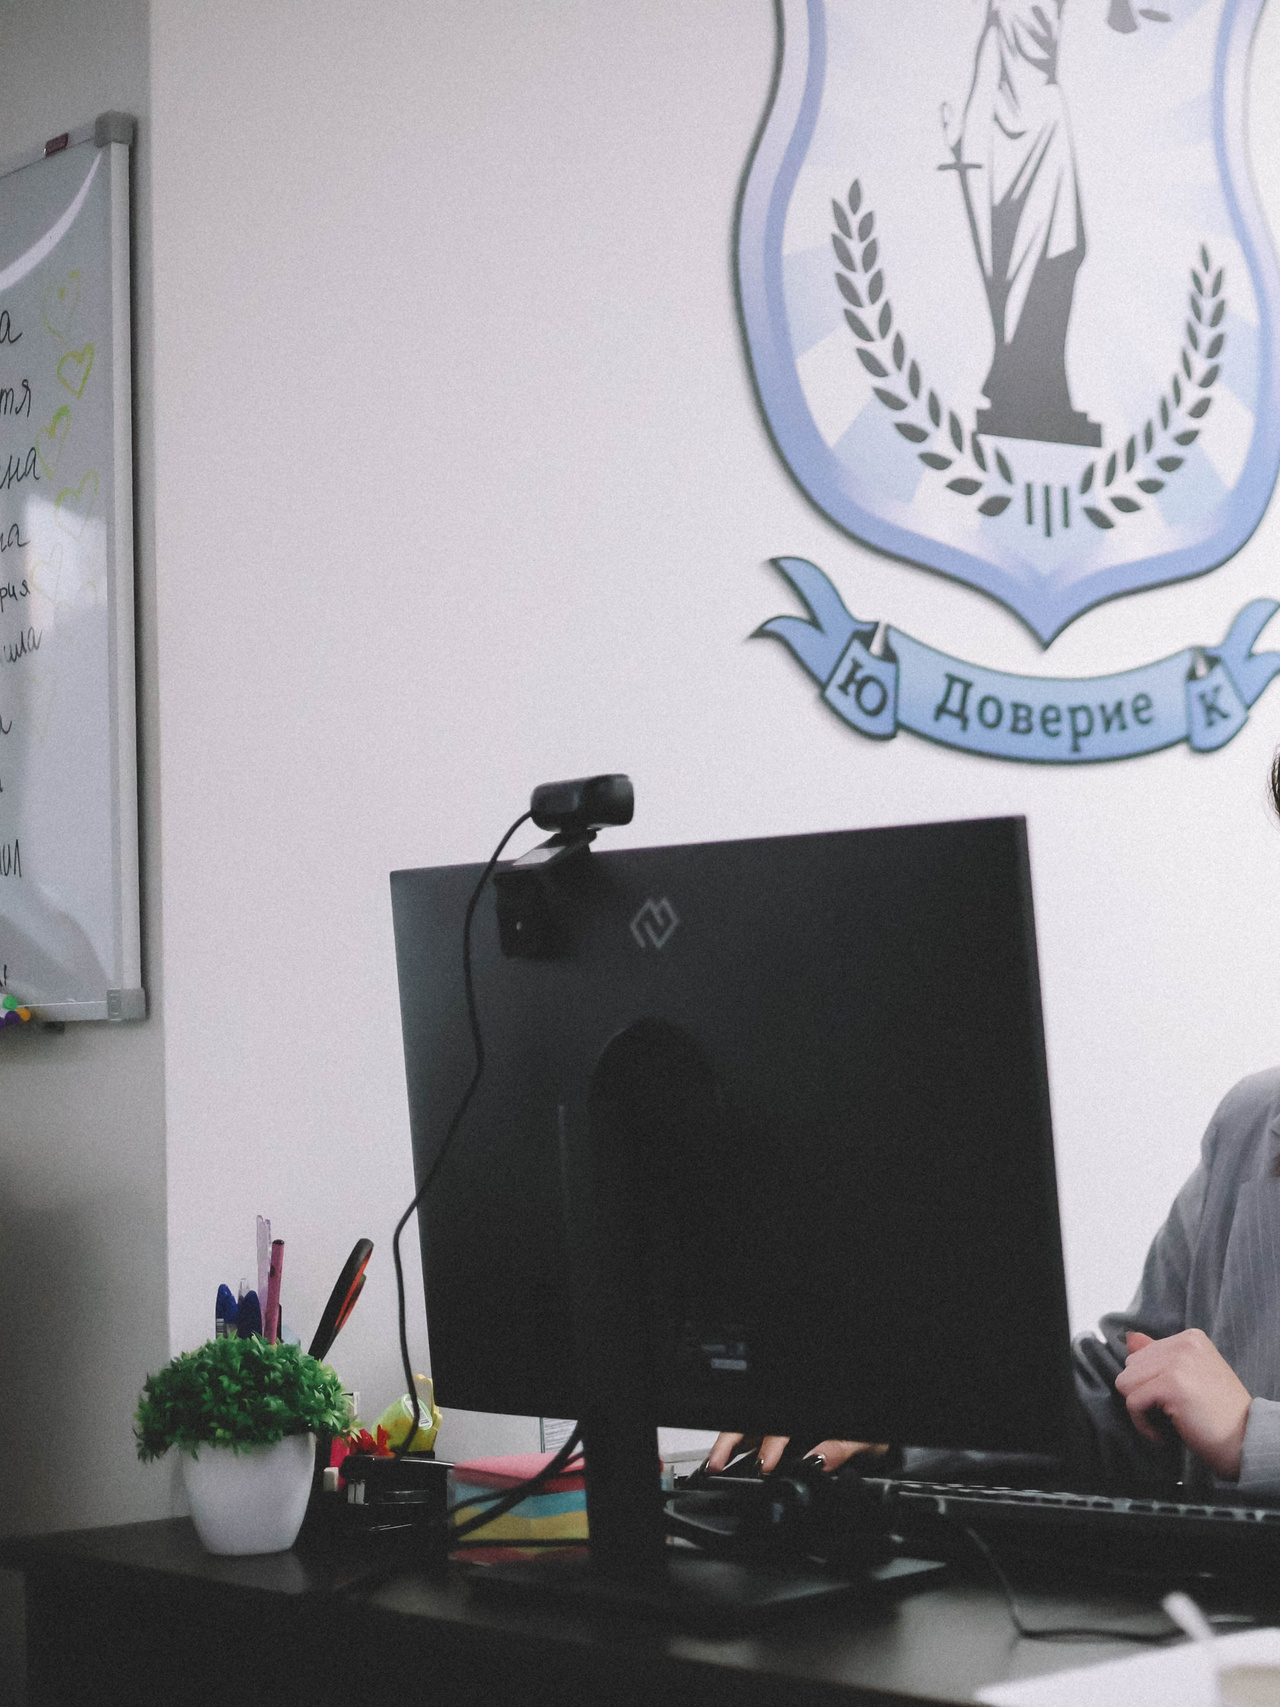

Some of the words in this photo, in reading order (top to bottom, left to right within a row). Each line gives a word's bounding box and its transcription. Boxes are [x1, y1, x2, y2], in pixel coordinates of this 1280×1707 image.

[836, 655, 890, 719] Ю
[933, 671, 1155, 753] Доверие
[1195, 684, 1232, 729] К
